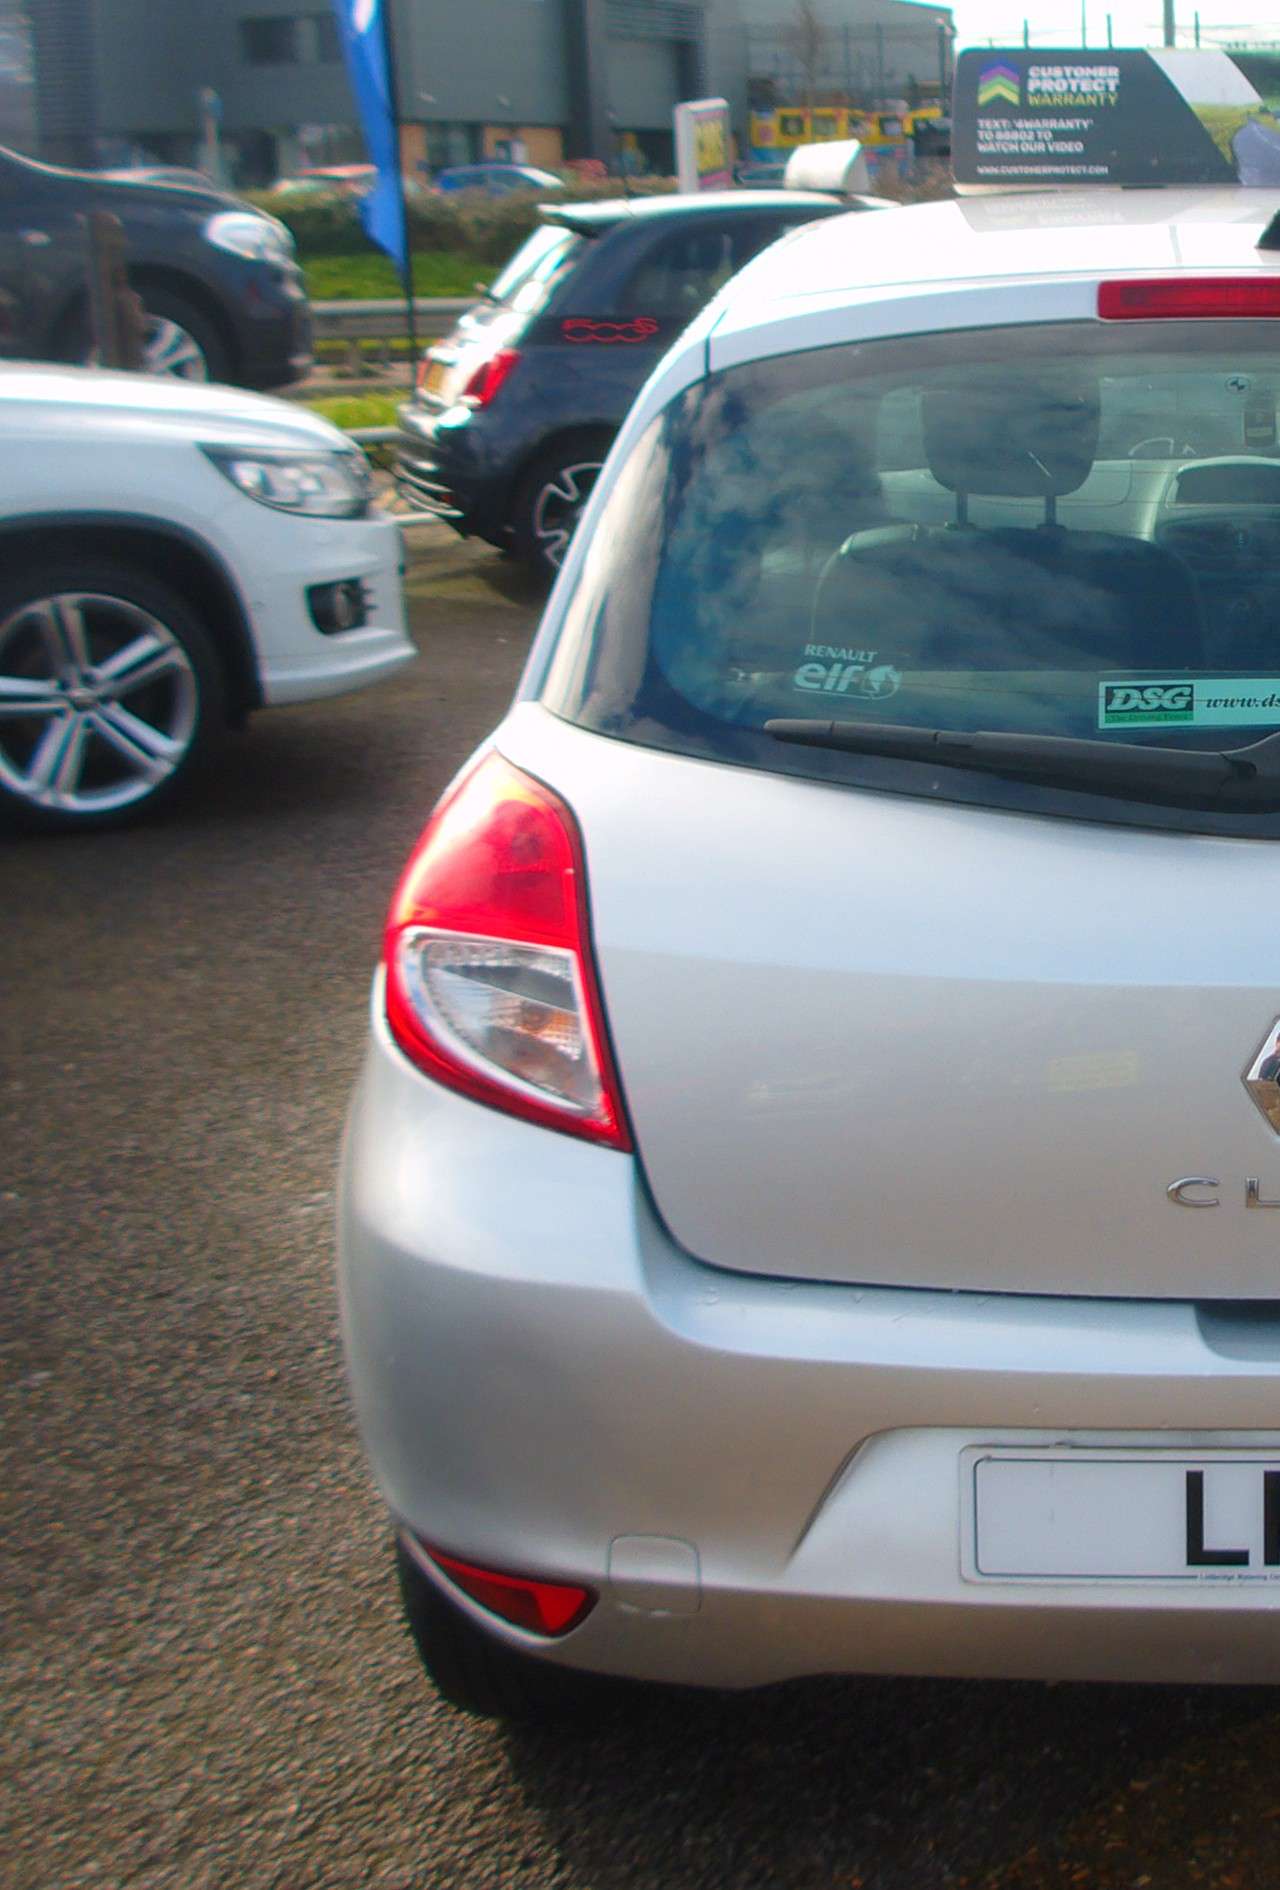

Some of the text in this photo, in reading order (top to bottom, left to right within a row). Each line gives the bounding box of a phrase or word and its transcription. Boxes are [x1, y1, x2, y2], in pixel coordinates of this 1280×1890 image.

[1027, 65, 1120, 78] CUSTOMER
[1027, 78, 1120, 92] PROTECT
[1027, 92, 1119, 106] WARRANTY
[976, 130, 994, 142] TO
[1036, 130, 1053, 142] TO
[976, 141, 1084, 153] WATCH OUR VIDEO
[803, 643, 879, 663] RENAULT
[794, 662, 865, 692] elf
[1106, 686, 1192, 711] DSG
